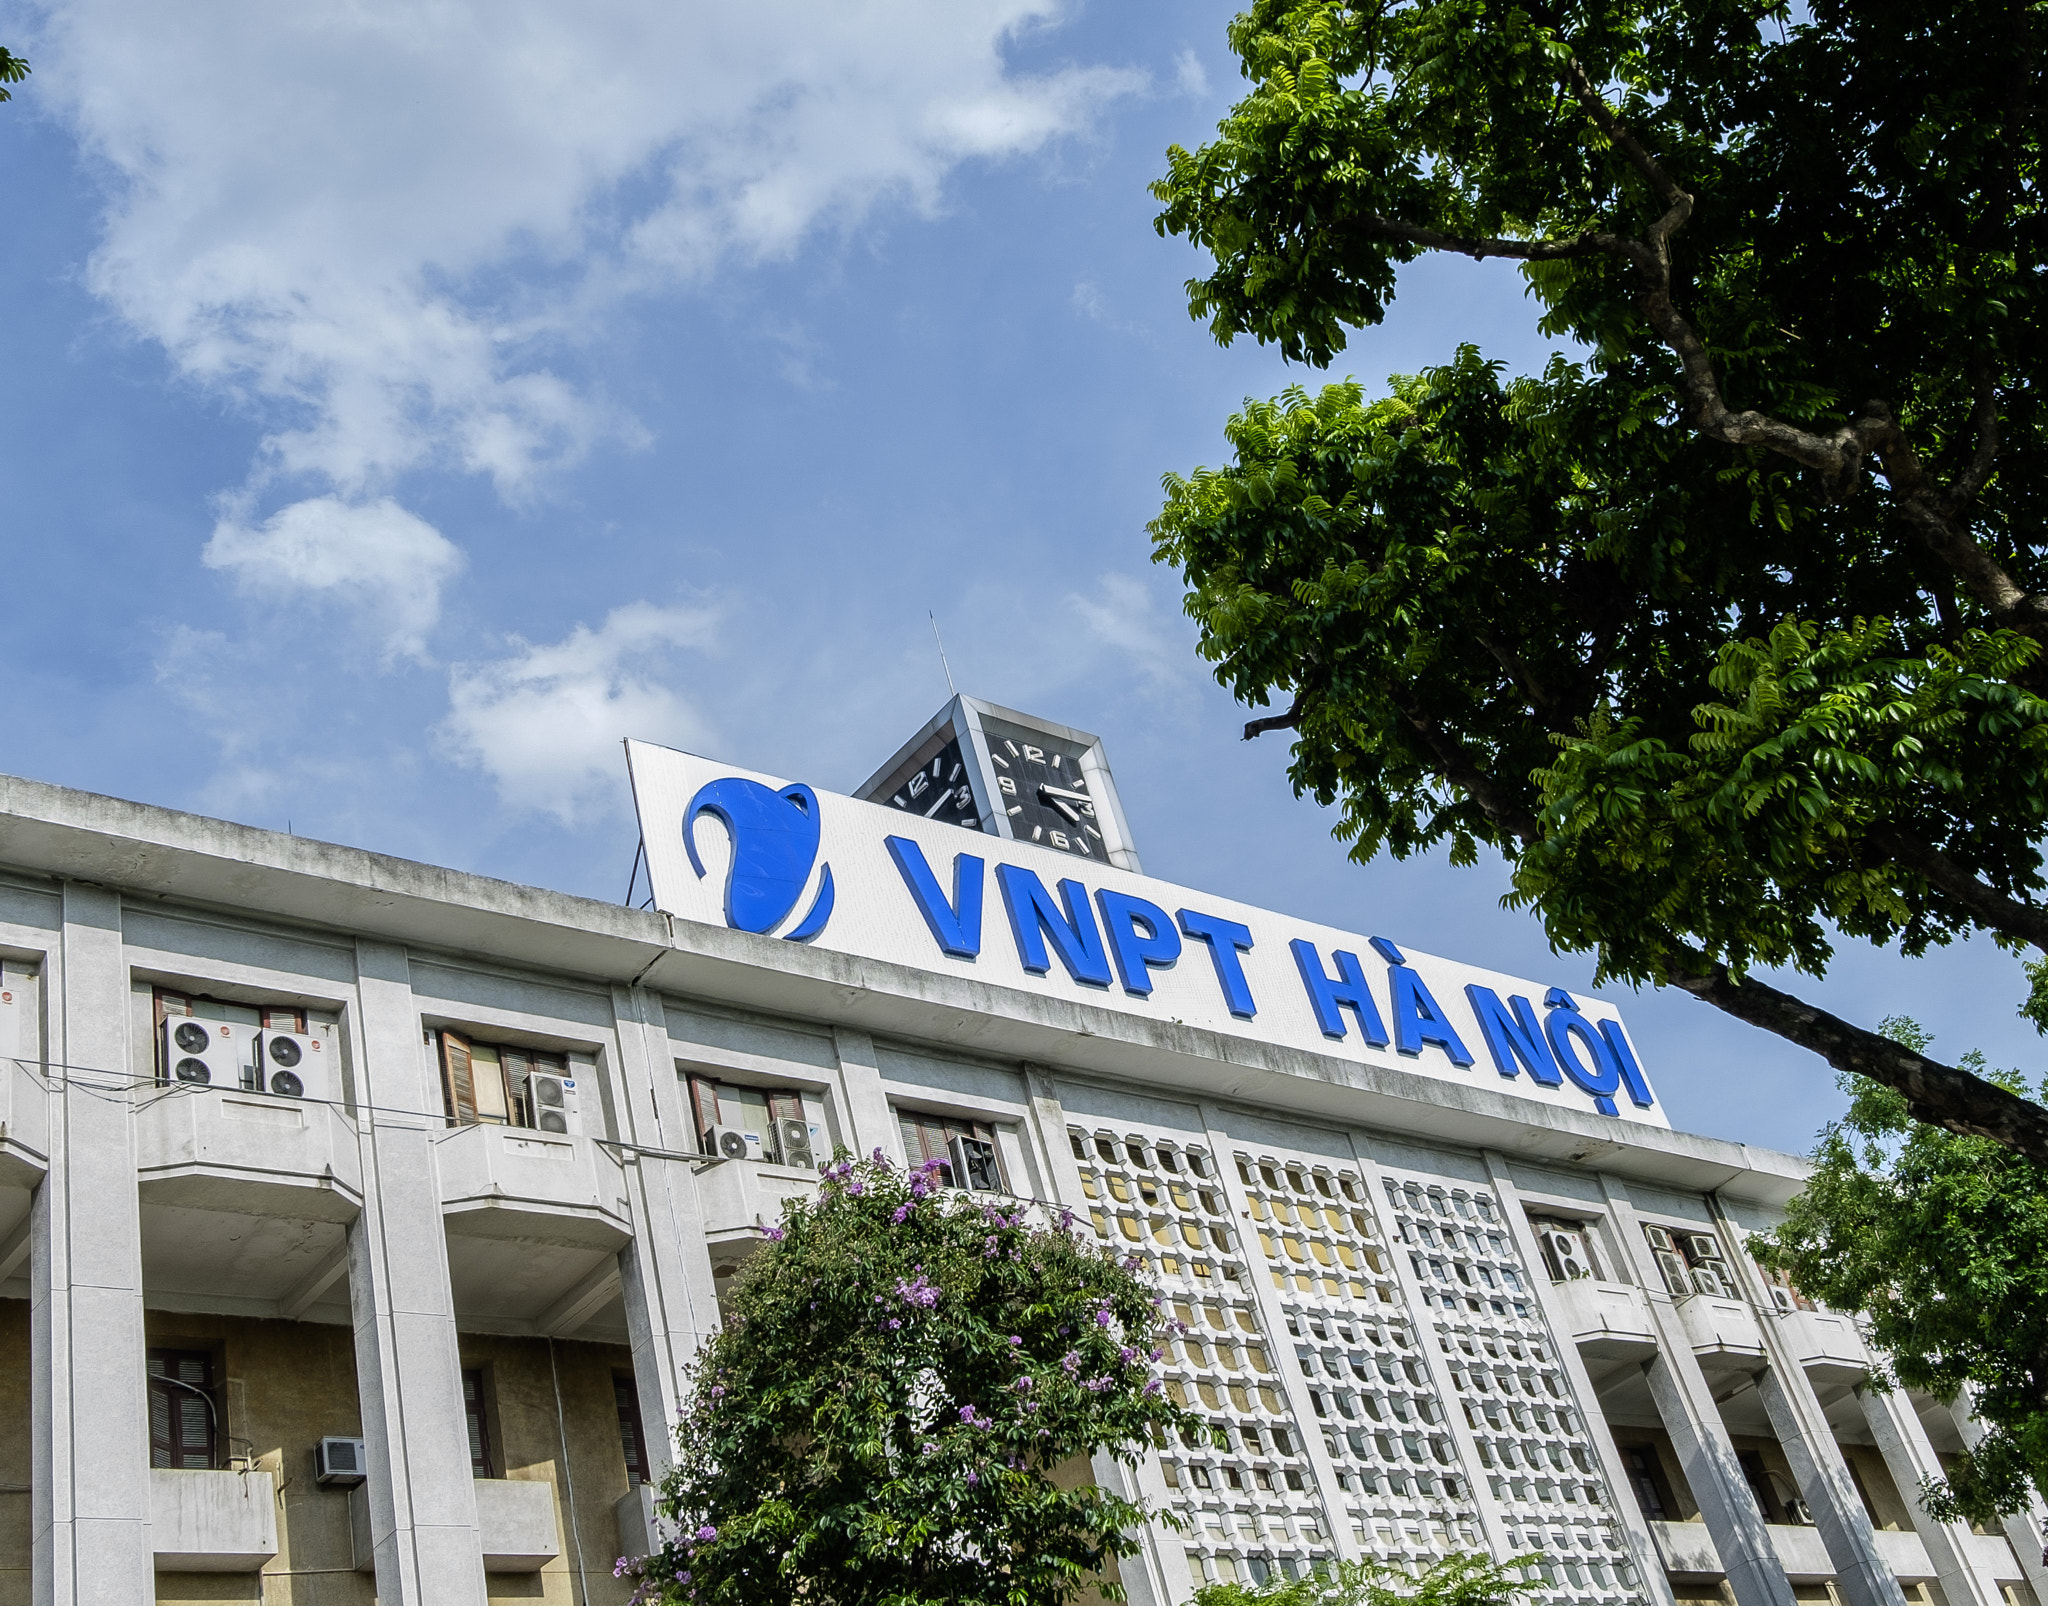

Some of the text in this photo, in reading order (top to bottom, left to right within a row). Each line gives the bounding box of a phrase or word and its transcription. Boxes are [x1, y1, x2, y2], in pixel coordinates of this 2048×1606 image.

[1022, 744, 1046, 766] 12
[908, 770, 929, 799] 12
[997, 776, 1017, 796] 9
[954, 785, 971, 810] 3
[1076, 800, 1095, 819] 3
[1049, 830, 1070, 850] 6
[884, 835, 1655, 1117] VNPT HÀ NỘI
